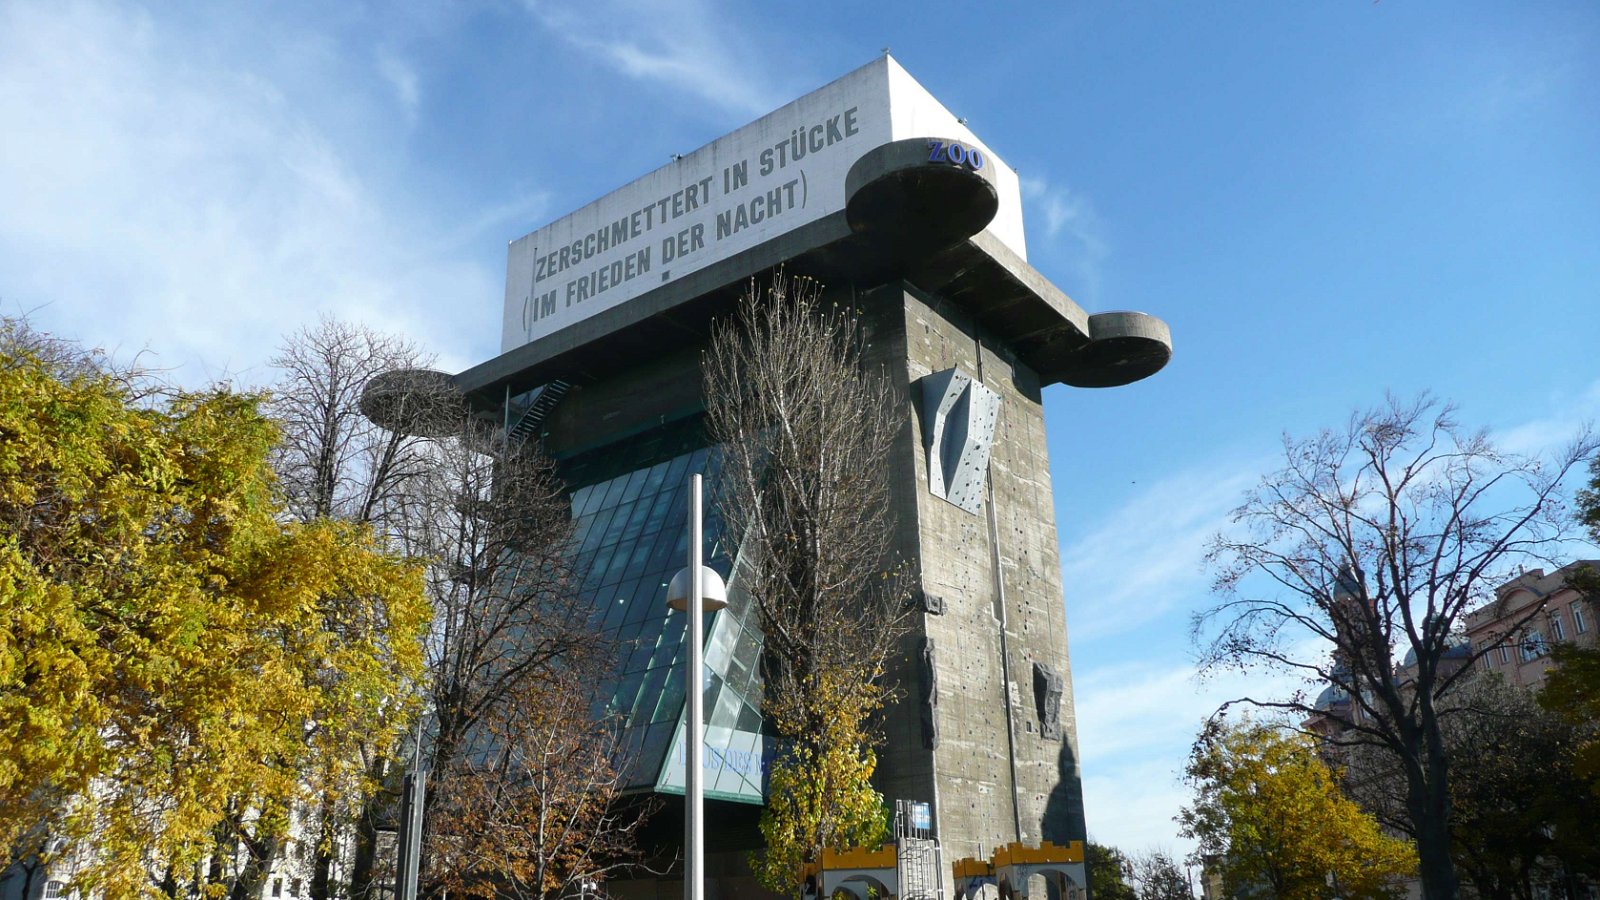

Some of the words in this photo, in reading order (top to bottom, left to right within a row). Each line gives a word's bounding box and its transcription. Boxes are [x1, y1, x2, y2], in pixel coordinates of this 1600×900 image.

[536, 176, 713, 283] ZERSCHMETTERT
[724, 160, 748, 194] IN
[760, 106, 859, 177] STÜCKE
[928, 141, 984, 170] ZOO
[566, 246, 651, 308] FRIEDEN
[662, 223, 705, 265] DER
